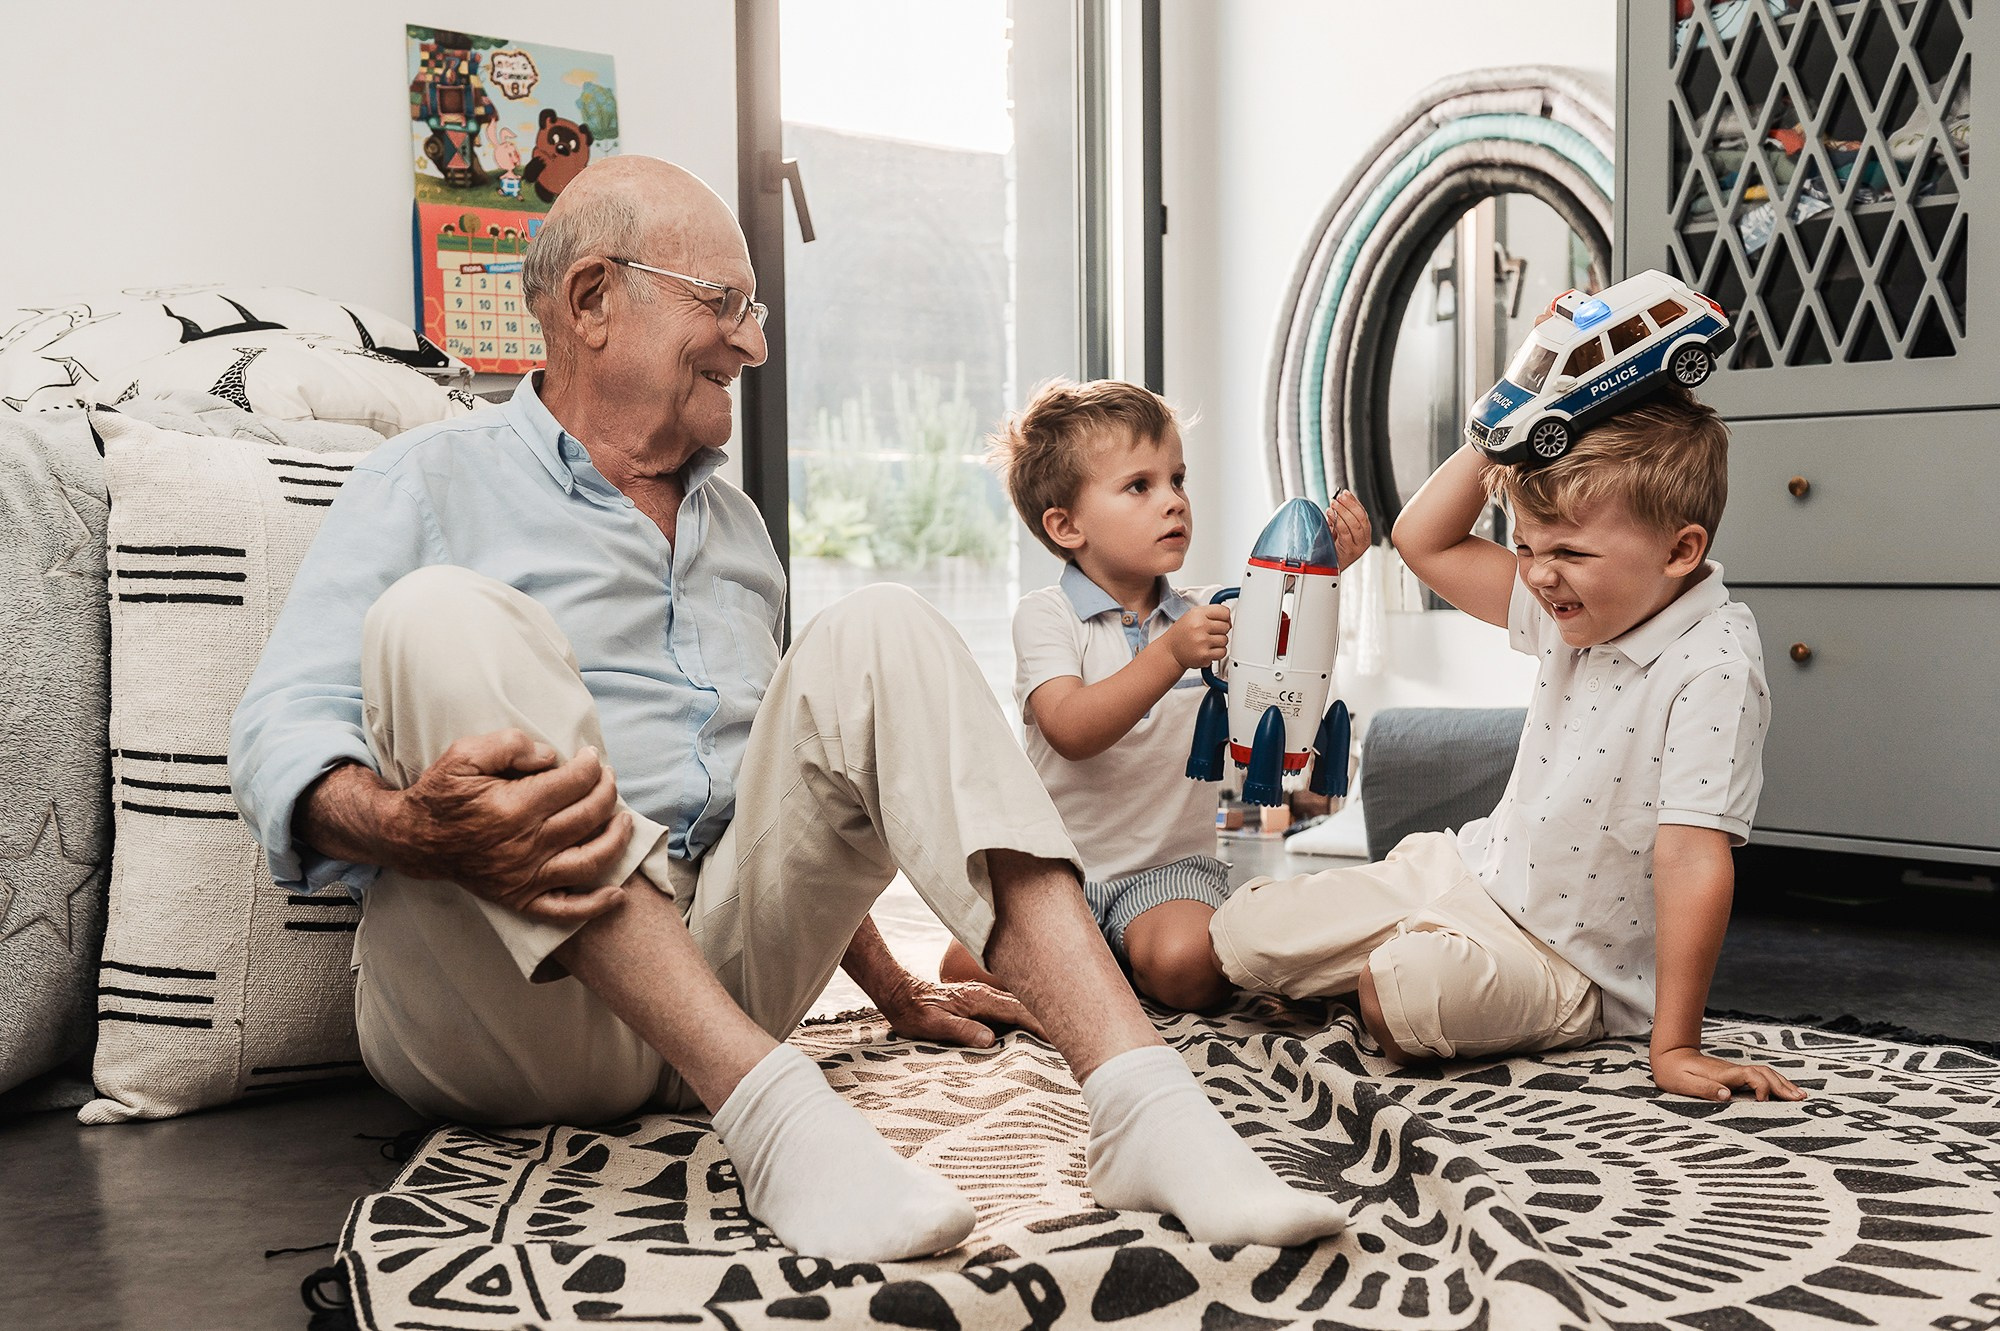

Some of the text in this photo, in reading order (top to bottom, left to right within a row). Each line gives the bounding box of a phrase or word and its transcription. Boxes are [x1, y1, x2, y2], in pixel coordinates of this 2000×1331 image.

[455, 276, 511, 290] 2 3 4
[456, 298, 515, 311] 9 10 11
[455, 319, 541, 333] 16 17 18 19
[479, 341, 493, 352] 24
[505, 343, 518, 354] 25
[529, 344, 542, 355] 26
[1590, 365, 1639, 397] POLICE
[1489, 391, 1514, 410] POLICE
